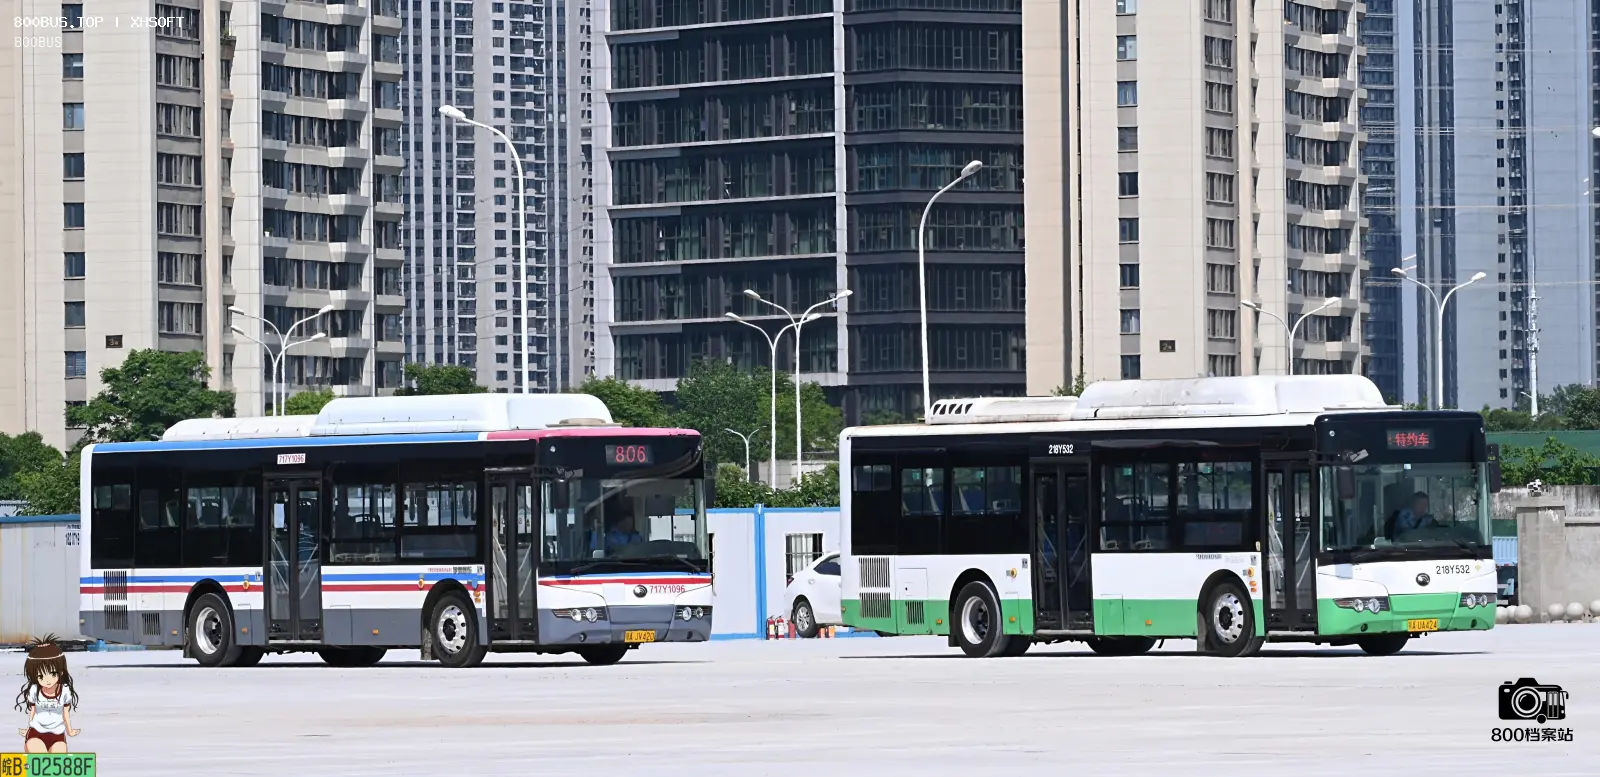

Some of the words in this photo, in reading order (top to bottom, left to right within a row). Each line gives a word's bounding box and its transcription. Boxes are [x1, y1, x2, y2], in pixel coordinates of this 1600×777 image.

[1395, 432, 1430, 447] 特约车
[615, 445, 646, 463] 806
[1048, 444, 1074, 454] 218Y532
[278, 453, 305, 463] 717Y1096
[1435, 564, 1470, 575] 218Y532
[649, 584, 686, 594] 717Y1096
